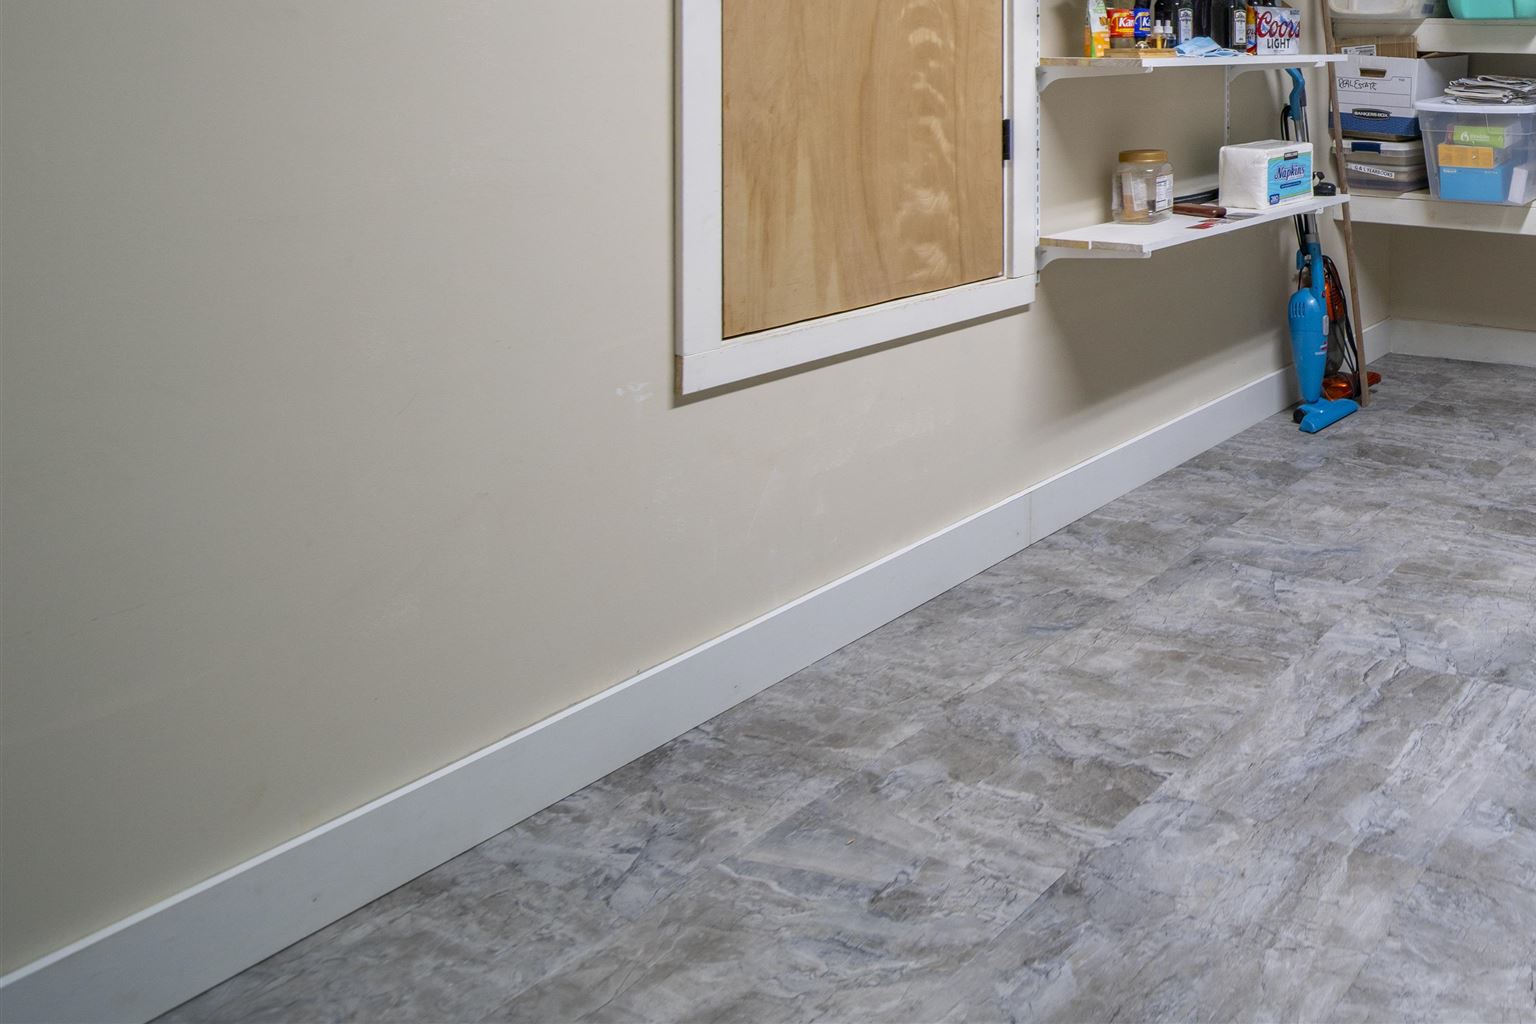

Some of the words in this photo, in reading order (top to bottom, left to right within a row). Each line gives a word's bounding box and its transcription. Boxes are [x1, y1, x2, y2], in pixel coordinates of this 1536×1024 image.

[1119, 17, 1134, 27] Kar
[1256, 11, 1300, 38] Coors
[1266, 38, 1291, 49] LIGHT
